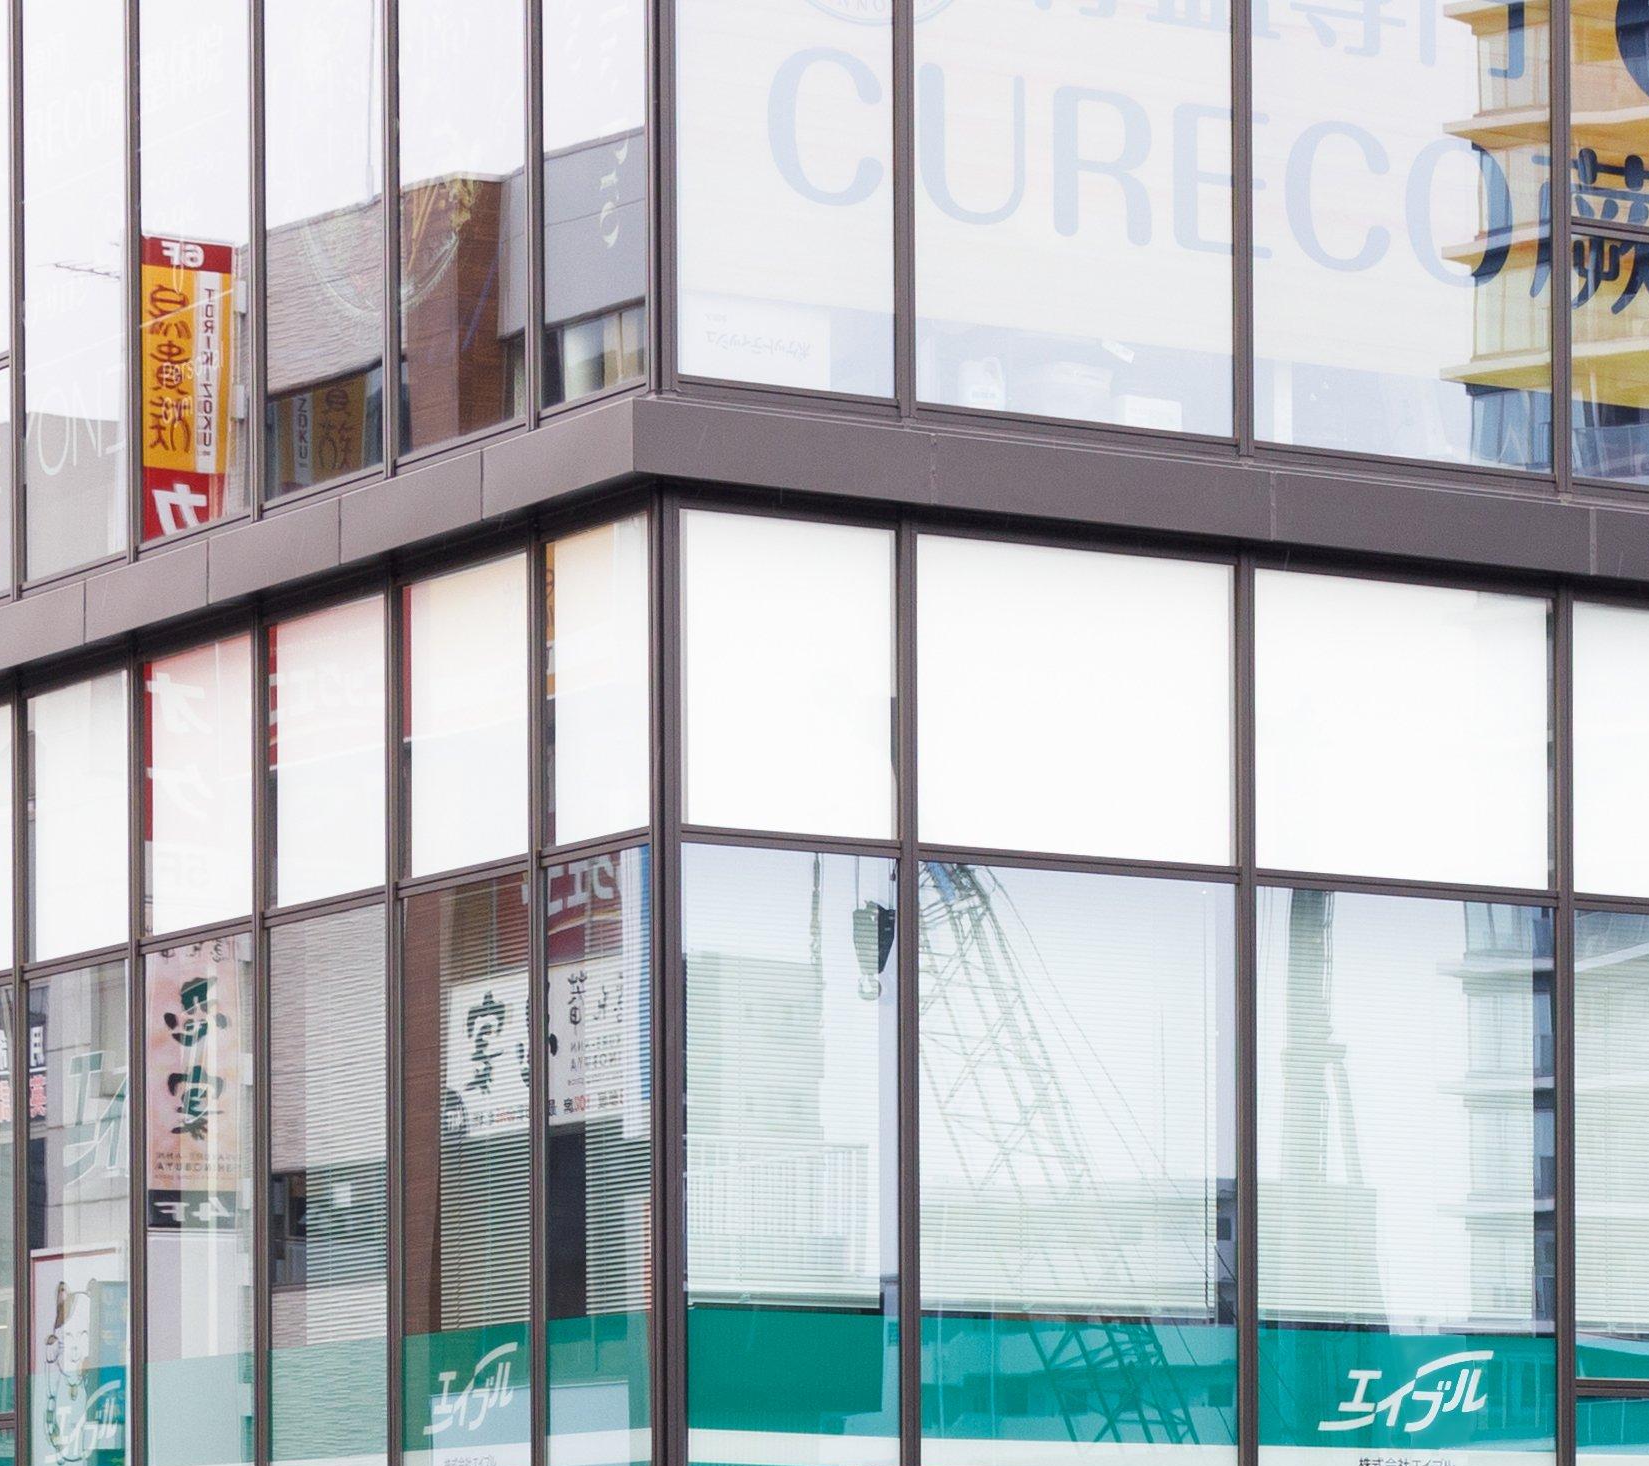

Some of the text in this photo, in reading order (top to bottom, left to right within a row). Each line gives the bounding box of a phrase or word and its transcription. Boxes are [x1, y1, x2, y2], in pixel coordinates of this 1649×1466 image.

[422, 1341, 518, 1435] エイブル
[1317, 1350, 1494, 1432] エイブル
